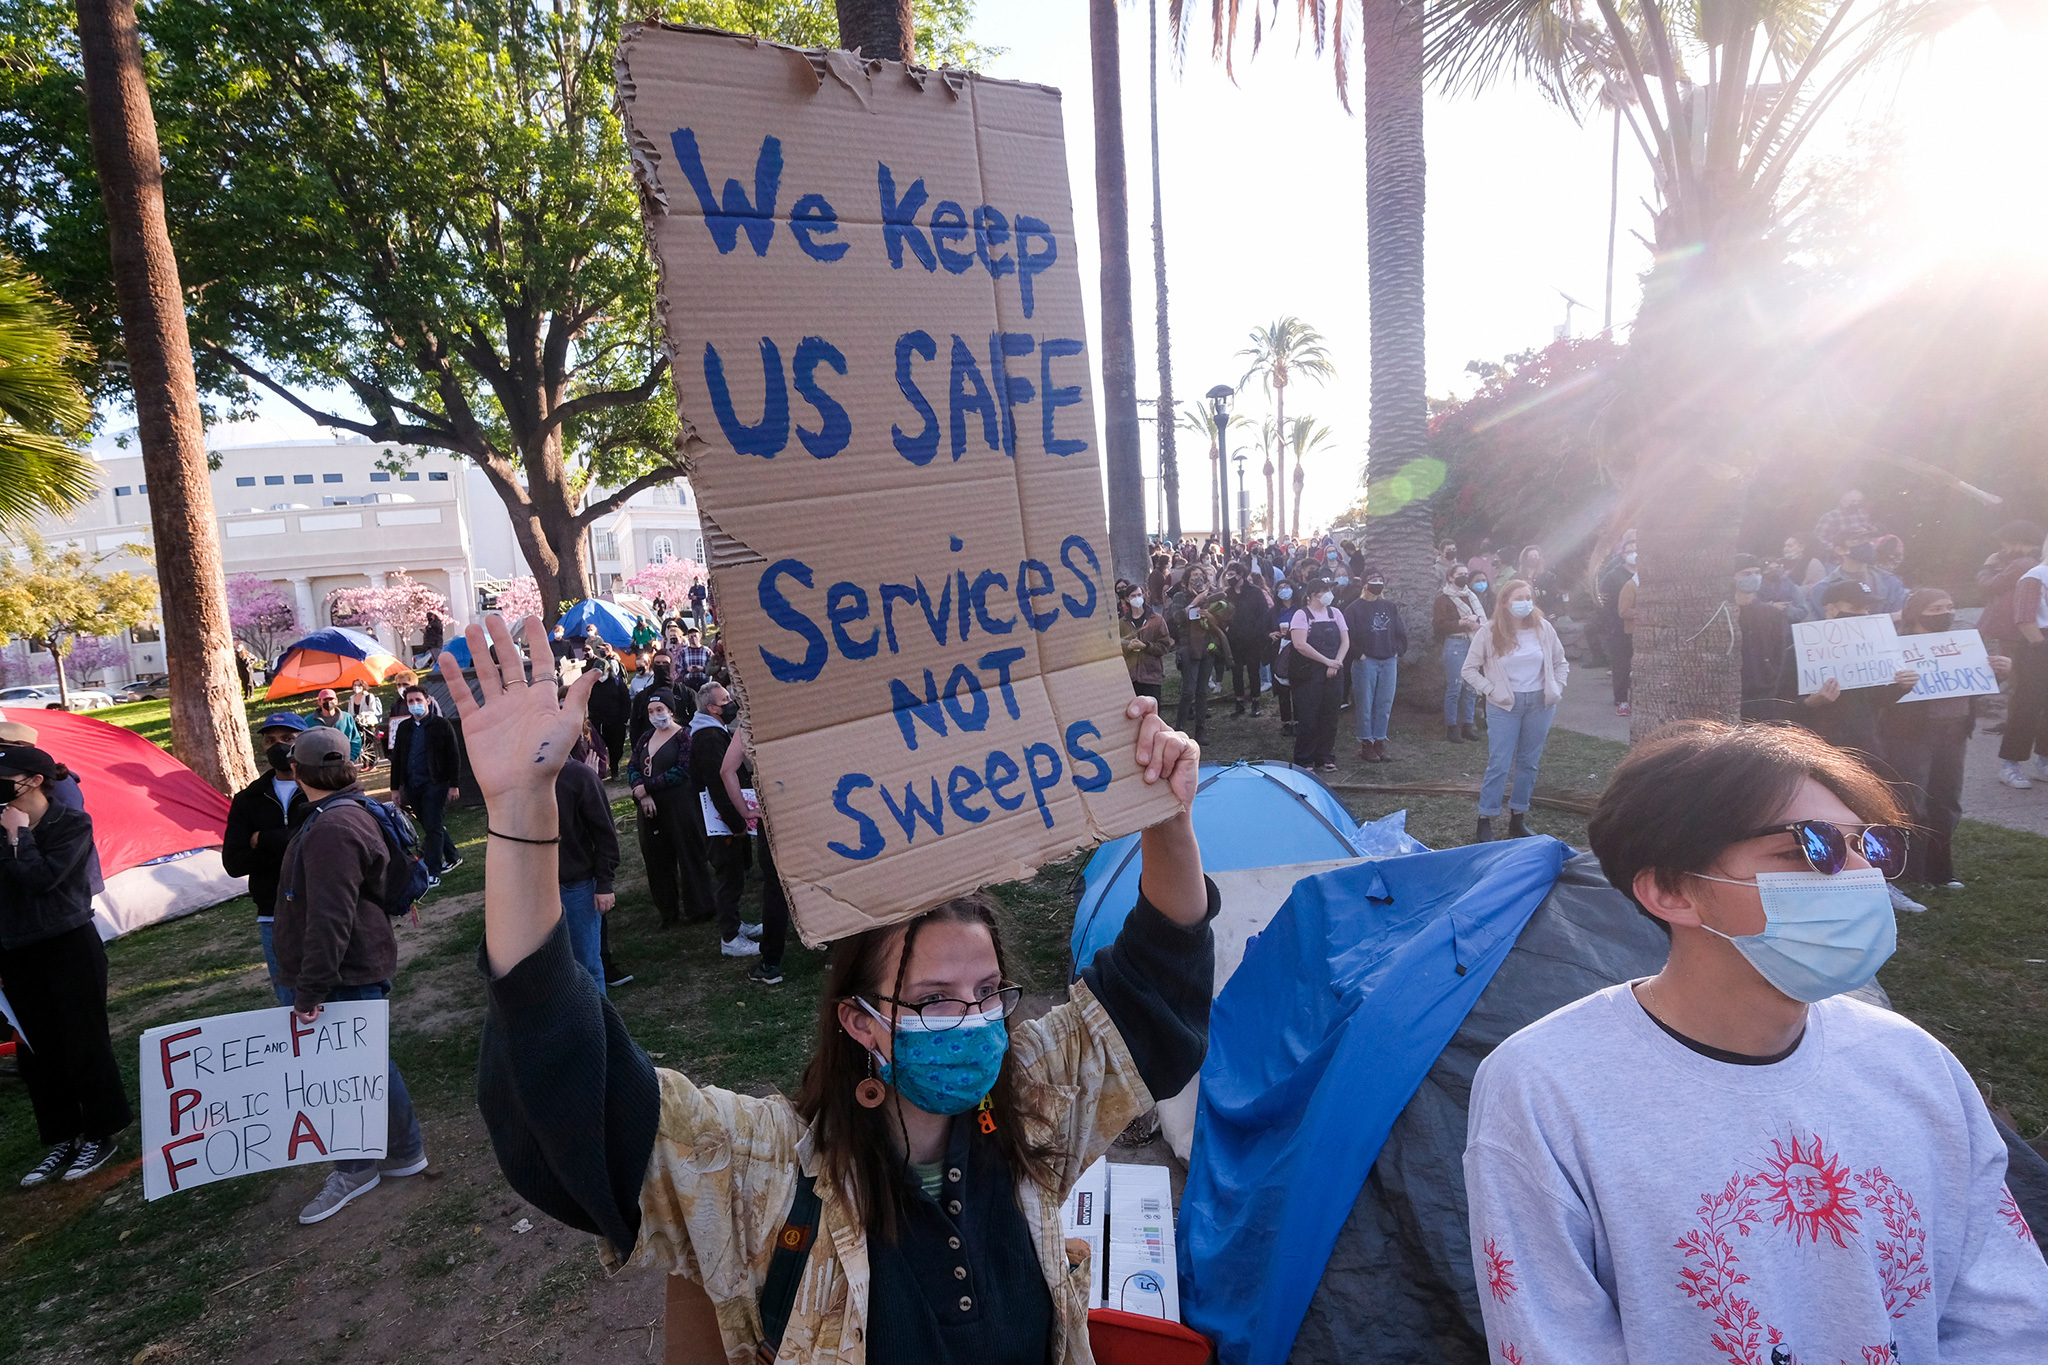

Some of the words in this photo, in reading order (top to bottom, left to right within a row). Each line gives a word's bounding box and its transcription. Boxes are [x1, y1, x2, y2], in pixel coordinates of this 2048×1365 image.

[669, 127, 851, 263] We
[703, 335, 852, 460] US
[891, 329, 1088, 466] SAFE
[757, 534, 1101, 683] Services
[1806, 644, 1849, 662] EVICT
[1855, 641, 1874, 656] MY
[888, 646, 1026, 751] NOT
[1916, 659, 1939, 673] my
[160, 1027, 266, 1090] FREE
[263, 1041, 289, 1054] AND
[290, 1005, 368, 1058] FAIR
[170, 1088, 270, 1136] PUBLIC
[285, 1069, 385, 1110] HOUSING
[161, 1132, 272, 1192] FOR
[287, 1105, 384, 1161] ALL
